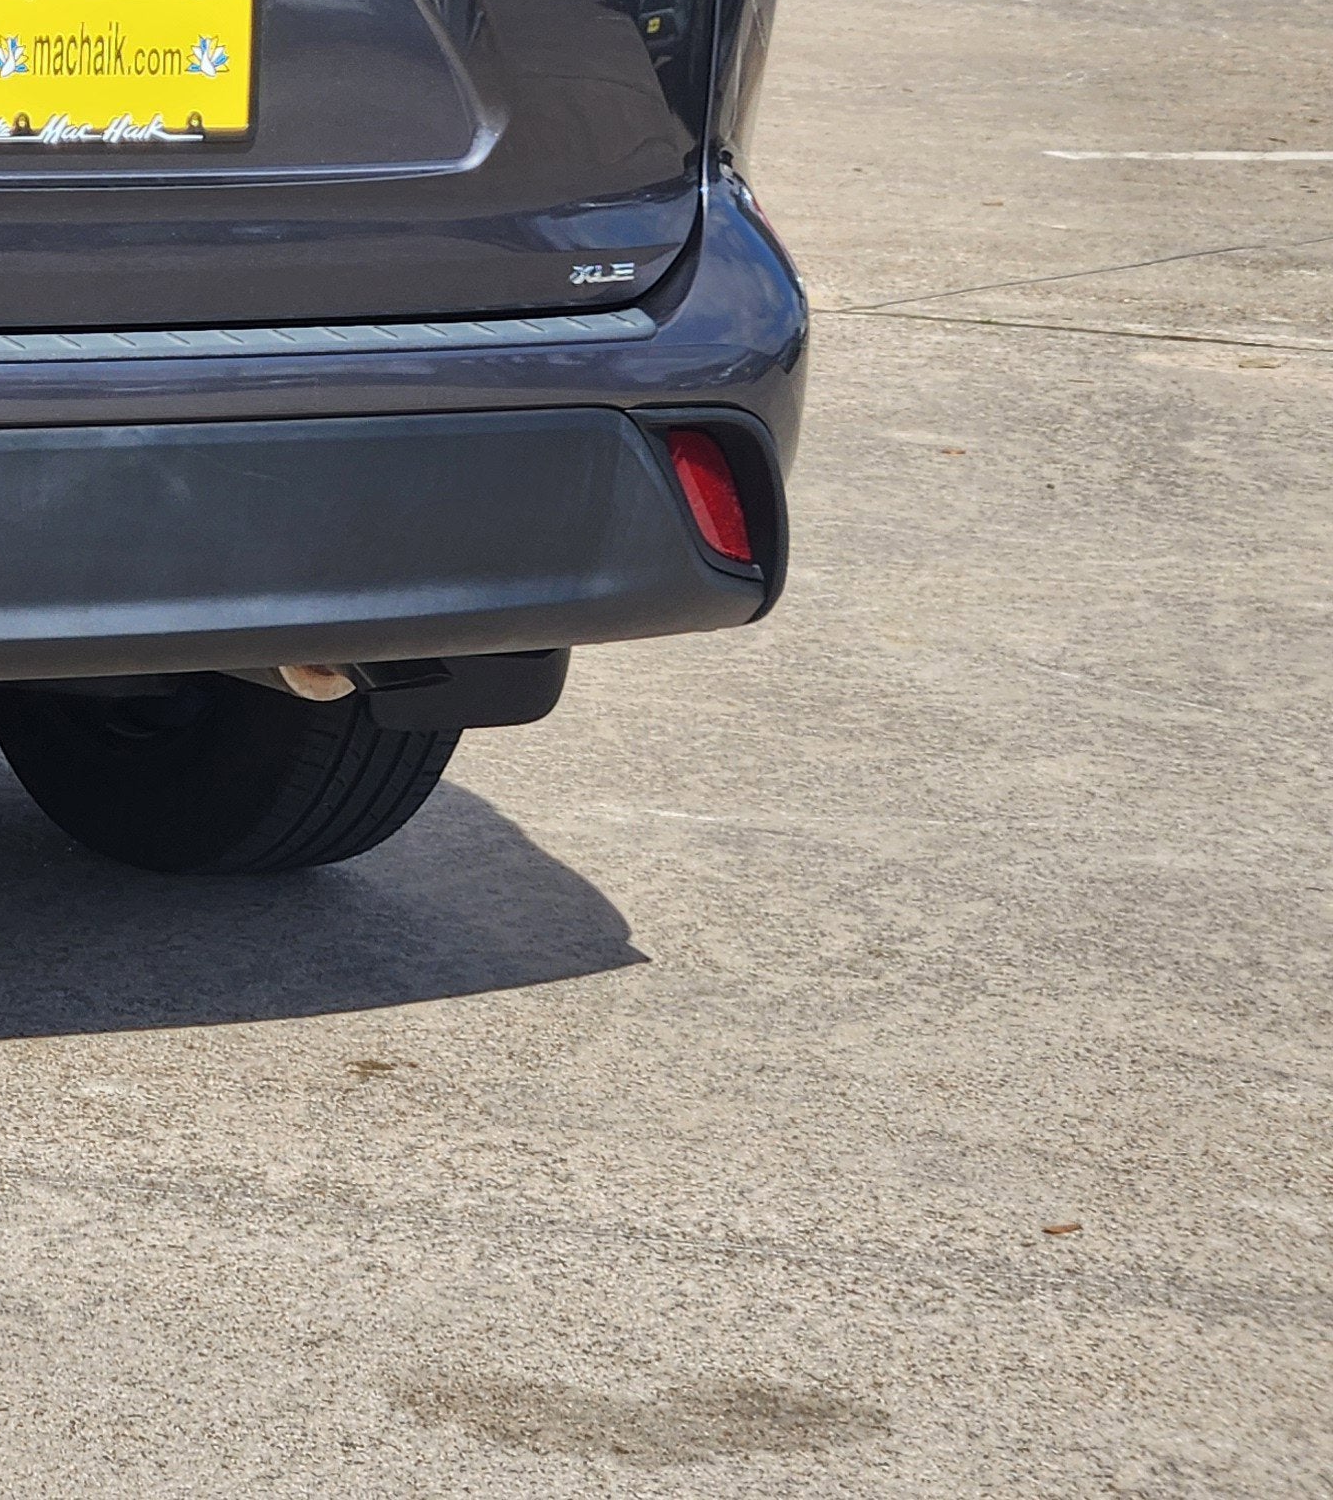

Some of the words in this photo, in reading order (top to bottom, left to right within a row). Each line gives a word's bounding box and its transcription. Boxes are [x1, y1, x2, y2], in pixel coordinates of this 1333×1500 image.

[33, 21, 182, 76] machaik.com
[38, 113, 96, 143] Mac
[102, 113, 166, 143] Haik
[569, 262, 635, 285] XLE
